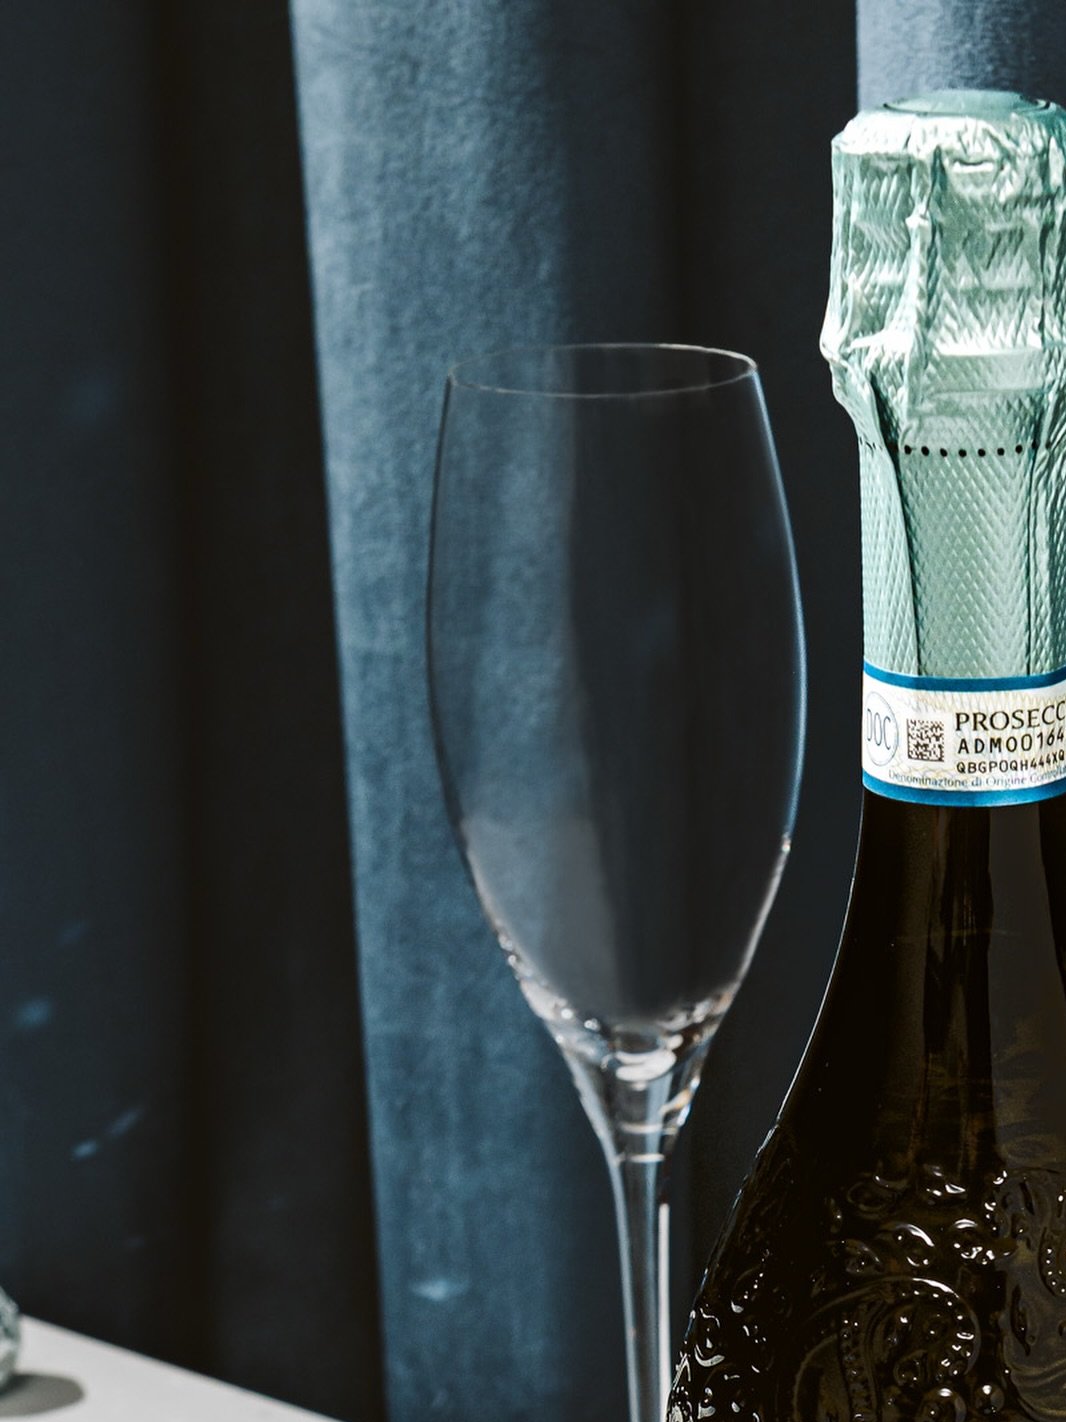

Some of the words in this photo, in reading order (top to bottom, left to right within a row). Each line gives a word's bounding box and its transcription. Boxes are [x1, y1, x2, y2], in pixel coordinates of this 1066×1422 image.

[866, 707, 892, 751] DOC
[971, 776, 982, 788] di
[985, 774, 1028, 789] Origine
